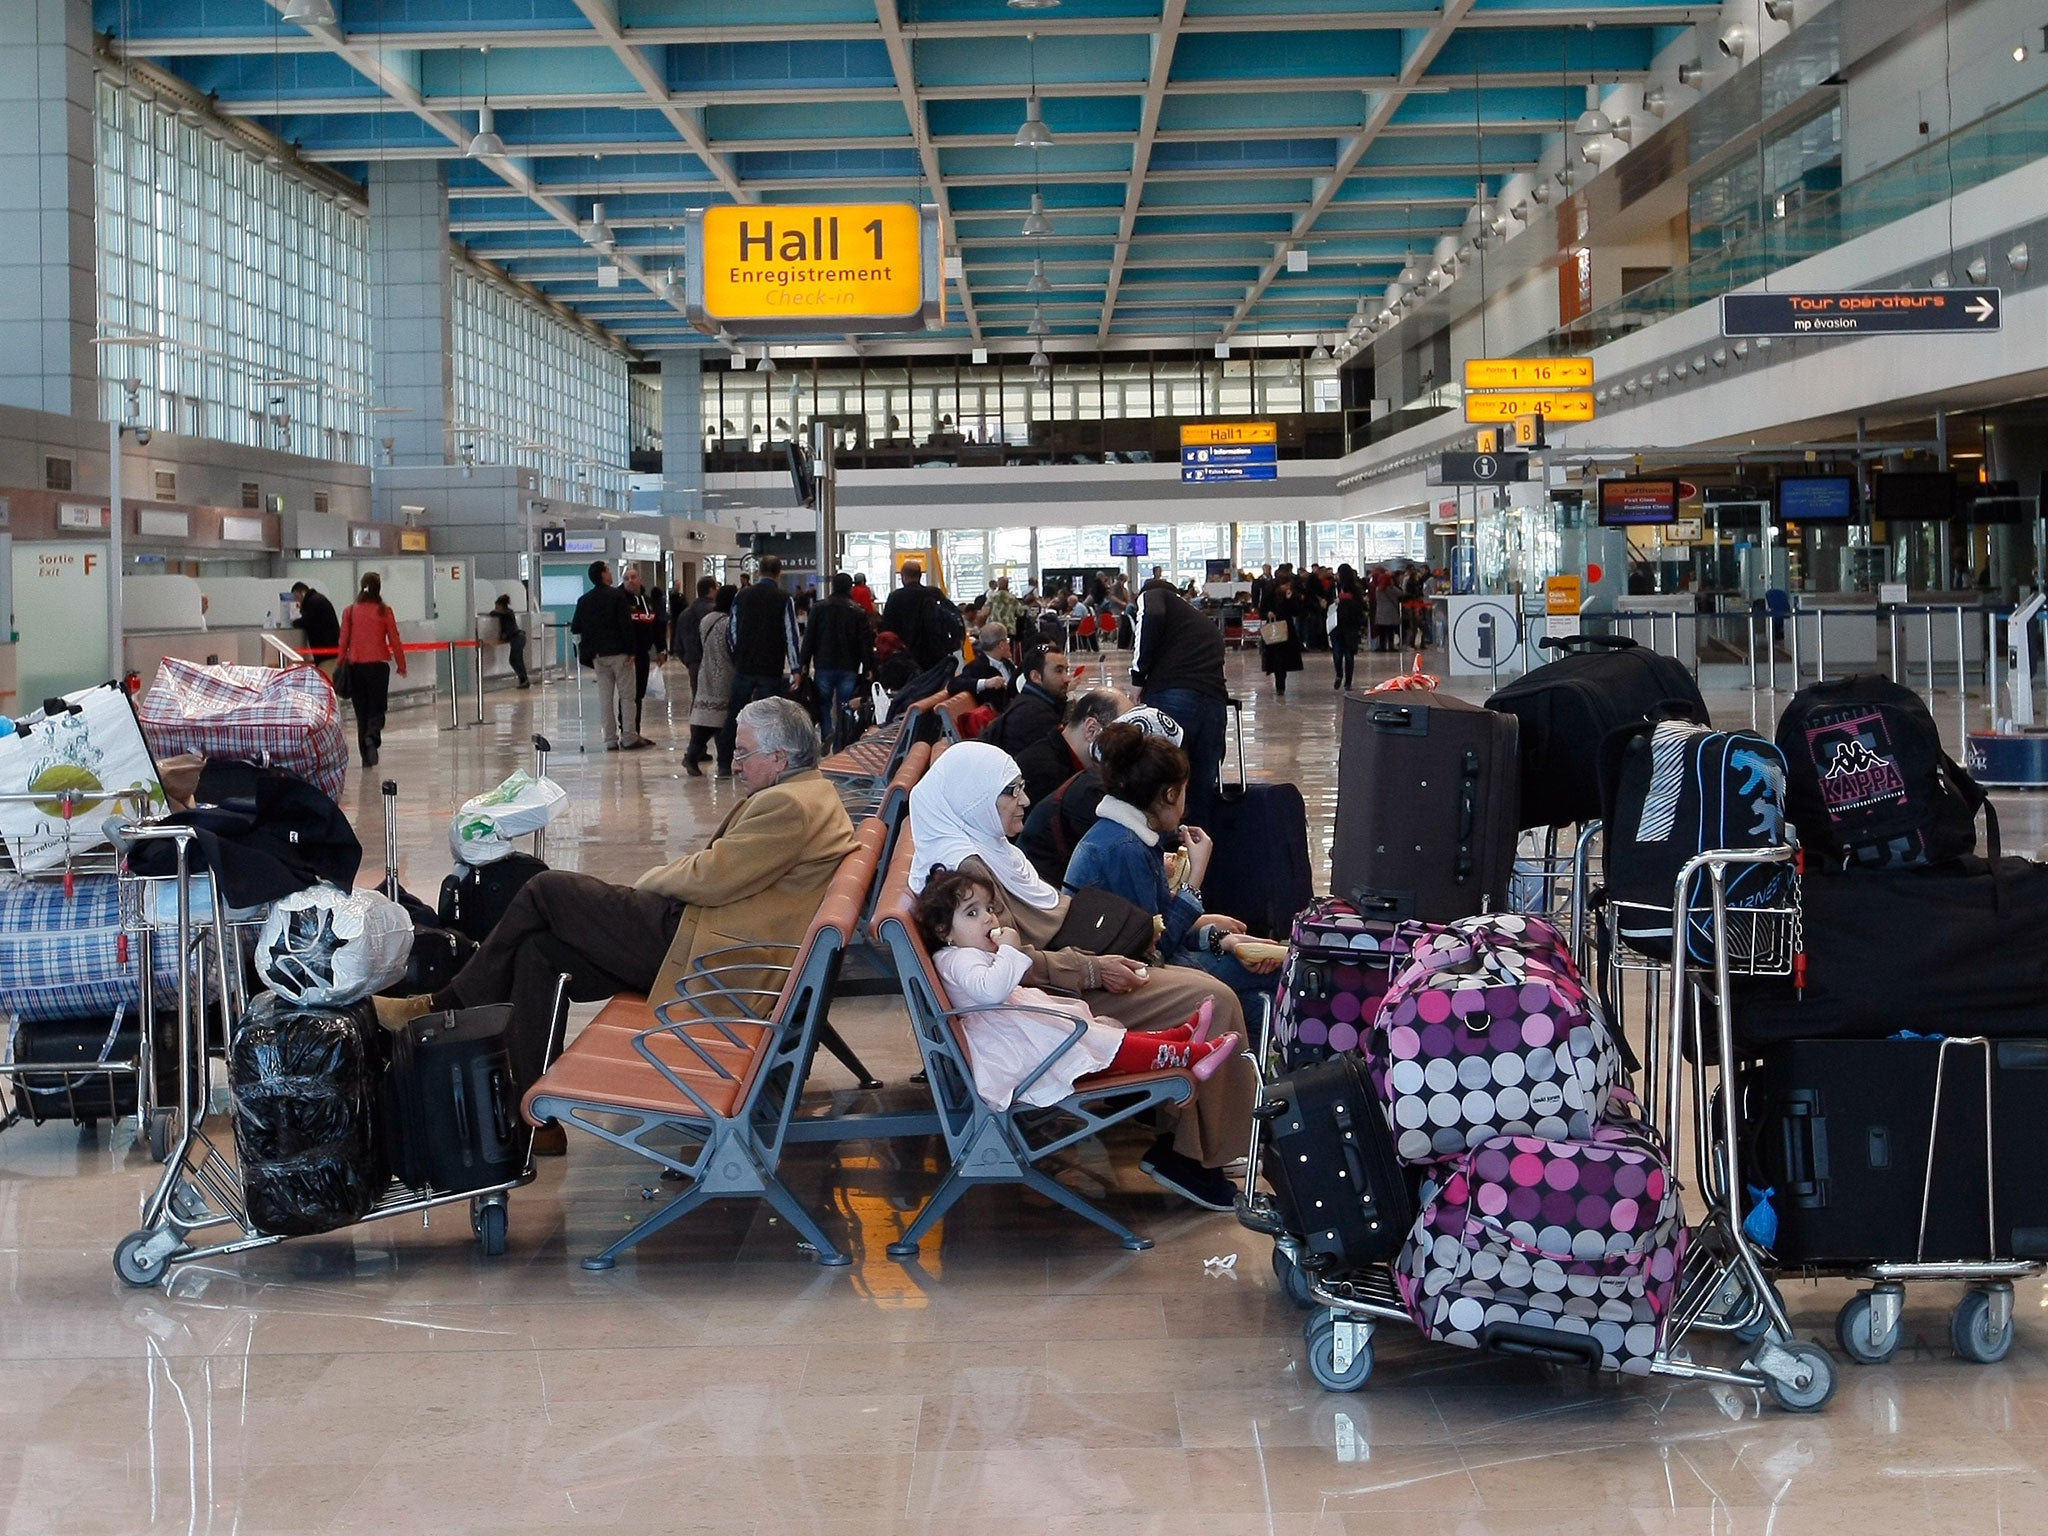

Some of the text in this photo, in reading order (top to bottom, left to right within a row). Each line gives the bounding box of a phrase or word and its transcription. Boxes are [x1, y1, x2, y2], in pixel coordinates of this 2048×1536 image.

[739, 217, 883, 262] Hall 1
[730, 266, 892, 286] Enregistrement
[766, 289, 855, 305] Check-in
[1789, 295, 1945, 312] Tour opérateurs
[1794, 318, 1857, 331] mp évasion
[1511, 368, 1518, 380] 1
[1535, 367, 1551, 379] 16
[1500, 401, 1518, 414] 20
[1534, 401, 1552, 414] 45
[1210, 429, 1234, 440] Hall
[1236, 429, 1243, 440] 1
[1523, 425, 1531, 440] B
[1483, 438, 1492, 451] A
[543, 532, 563, 548] P1
[39, 554, 74, 565] Sortie
[84, 553, 97, 576] F
[39, 567, 60, 577] Exit
[451, 566, 460, 580] E
[1820, 765, 1905, 803] KAPPA
